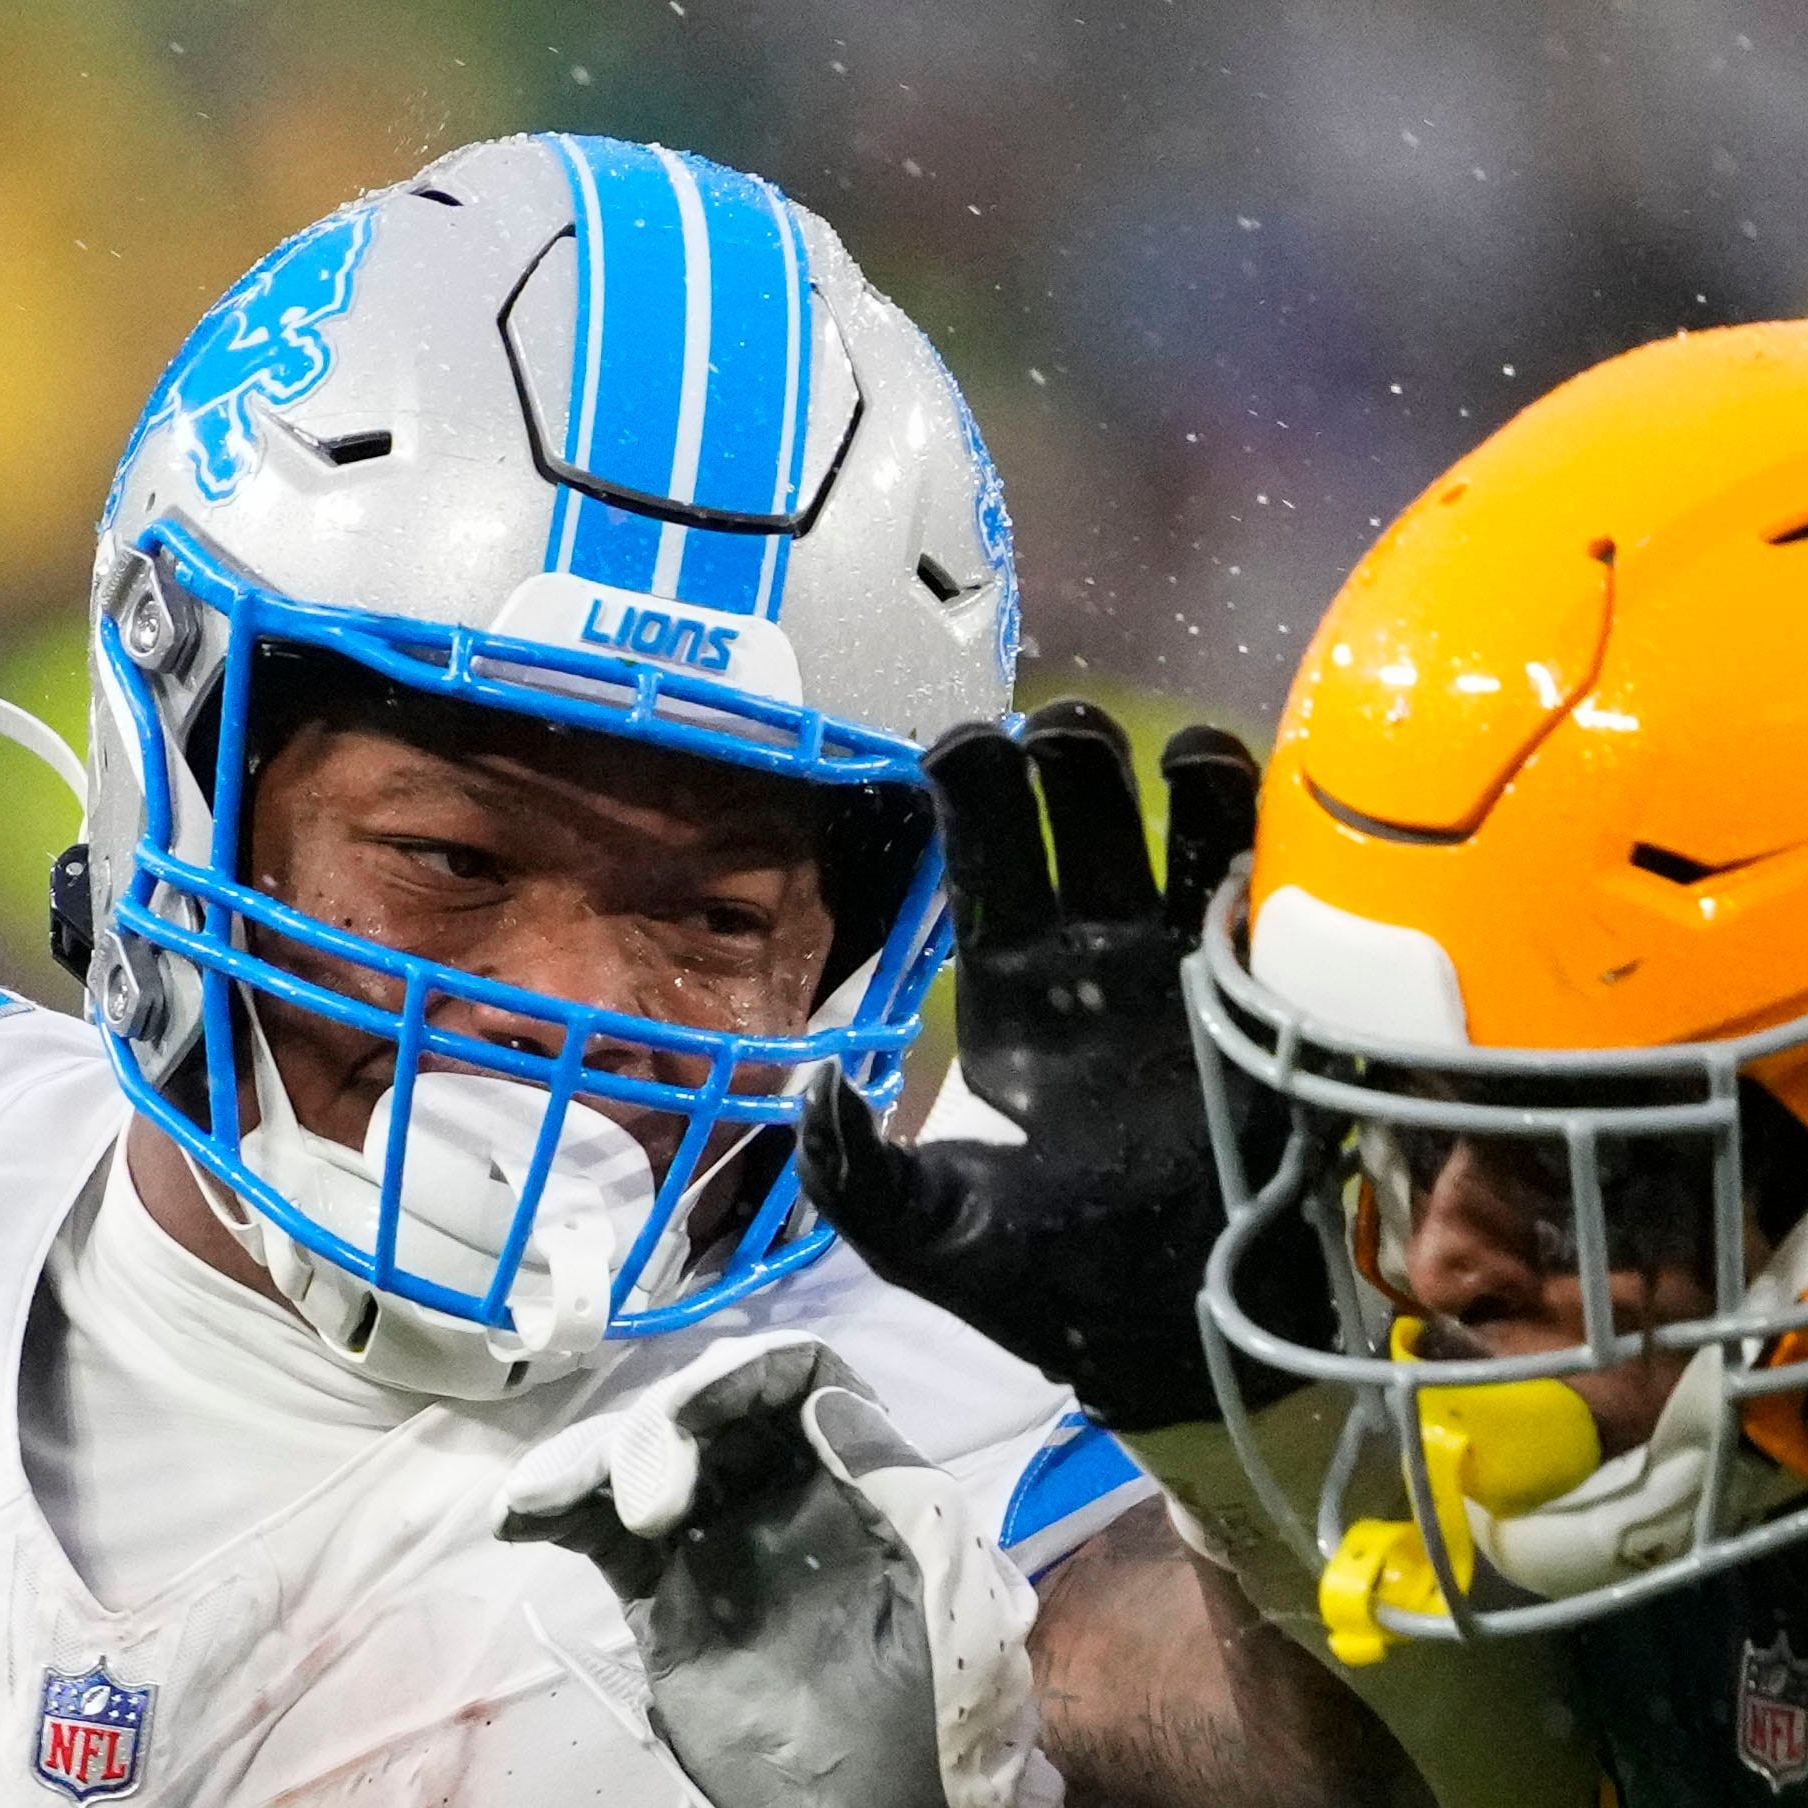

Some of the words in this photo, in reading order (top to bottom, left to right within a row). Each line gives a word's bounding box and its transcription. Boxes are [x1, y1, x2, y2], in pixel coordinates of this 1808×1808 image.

[581, 598, 740, 671] LIONS
[45, 1721, 128, 1784] NFL
[1749, 1703, 1802, 1762] NFL
